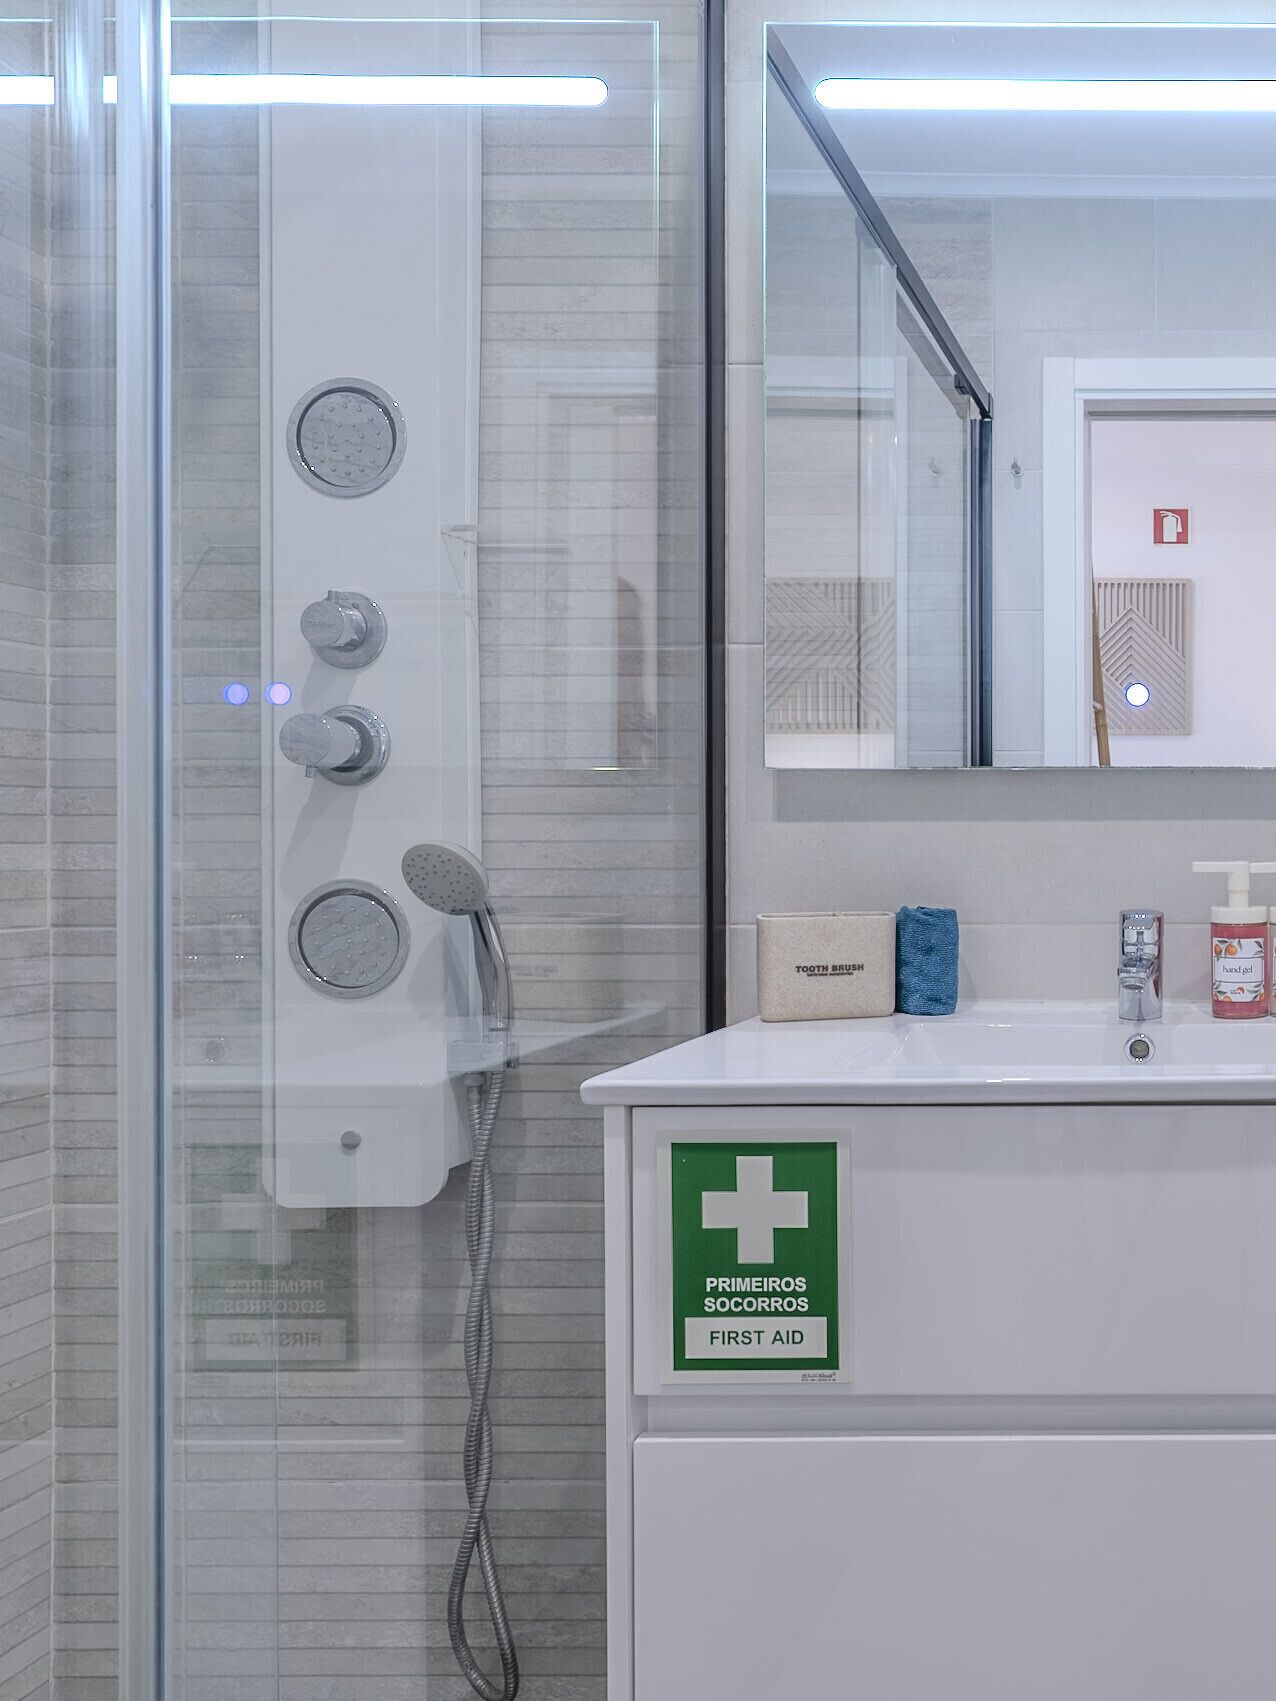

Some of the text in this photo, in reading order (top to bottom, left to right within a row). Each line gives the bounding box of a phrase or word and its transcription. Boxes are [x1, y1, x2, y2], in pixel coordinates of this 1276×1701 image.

[795, 964, 864, 973] TOOTH BRUSH
[1222, 965, 1253, 975] hand gel
[705, 1277, 807, 1293] PRIMEIROS
[703, 1297, 809, 1313] SOCORROS
[709, 1330, 804, 1346] FIRST AID
